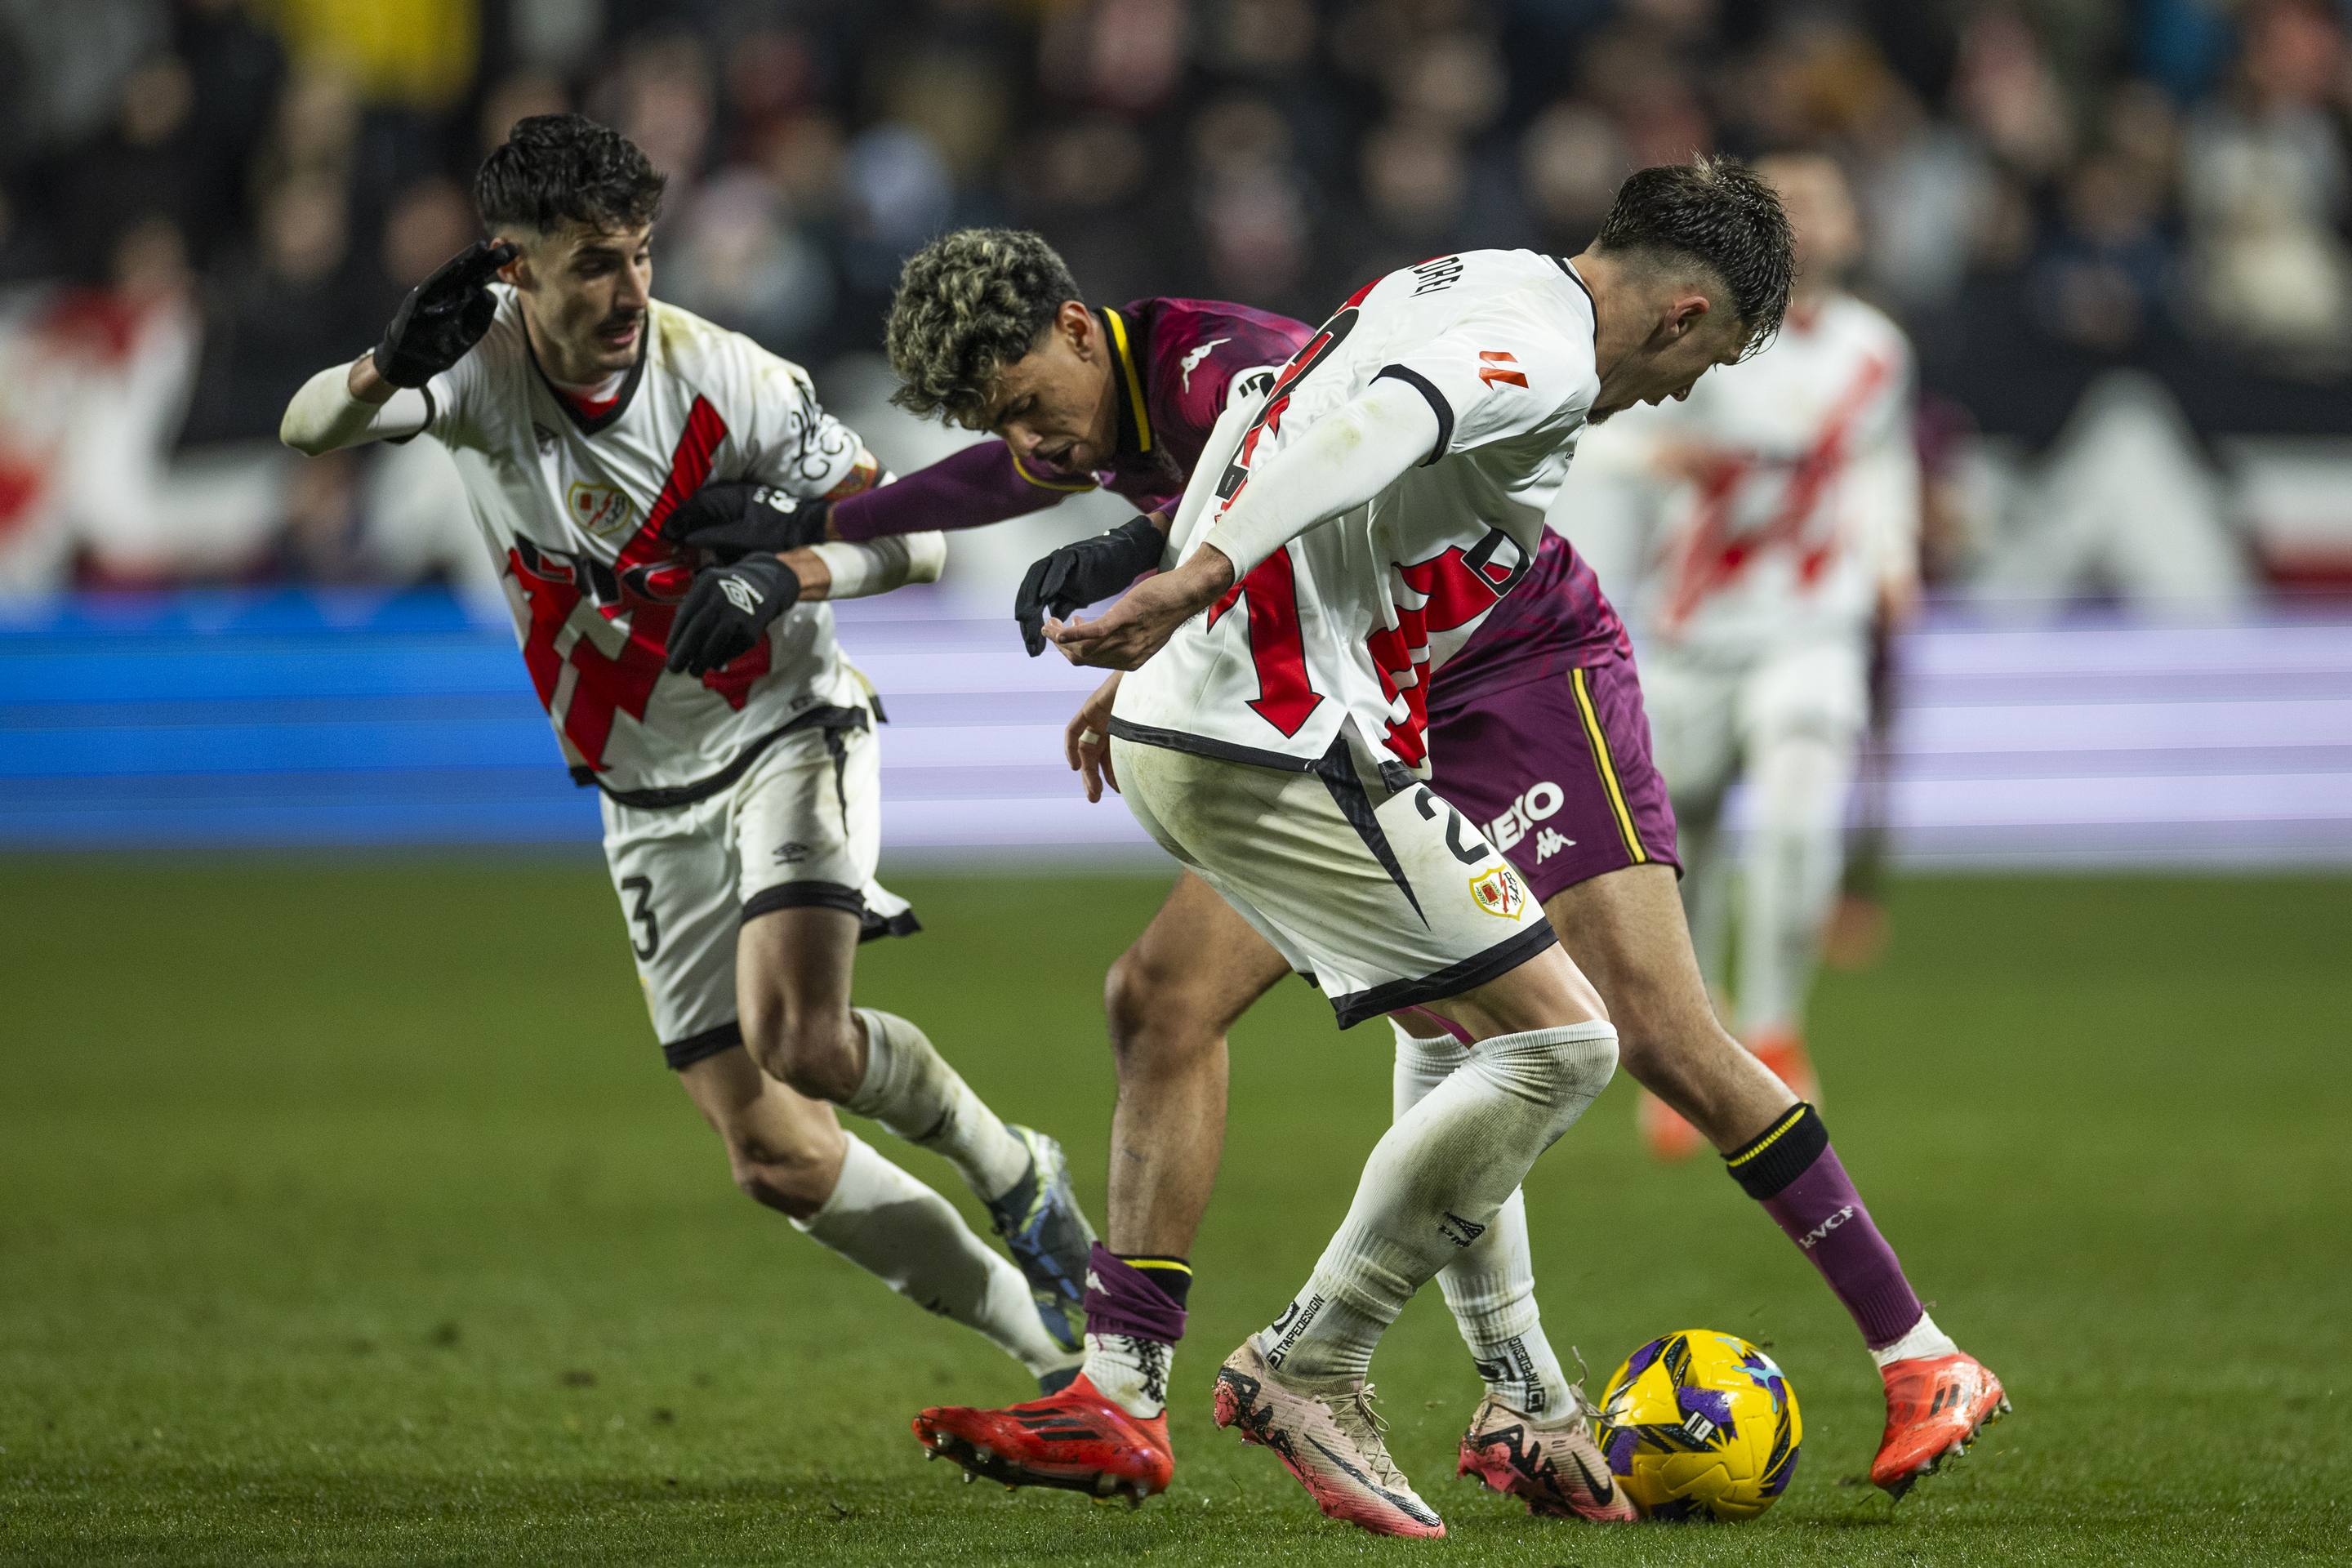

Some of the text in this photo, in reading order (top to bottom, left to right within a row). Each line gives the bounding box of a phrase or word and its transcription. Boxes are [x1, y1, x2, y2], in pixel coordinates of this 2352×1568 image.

[1414, 786, 1490, 866] 2
[621, 875, 659, 962] 3
[1276, 1293, 1325, 1352] TAPEDESIGN
